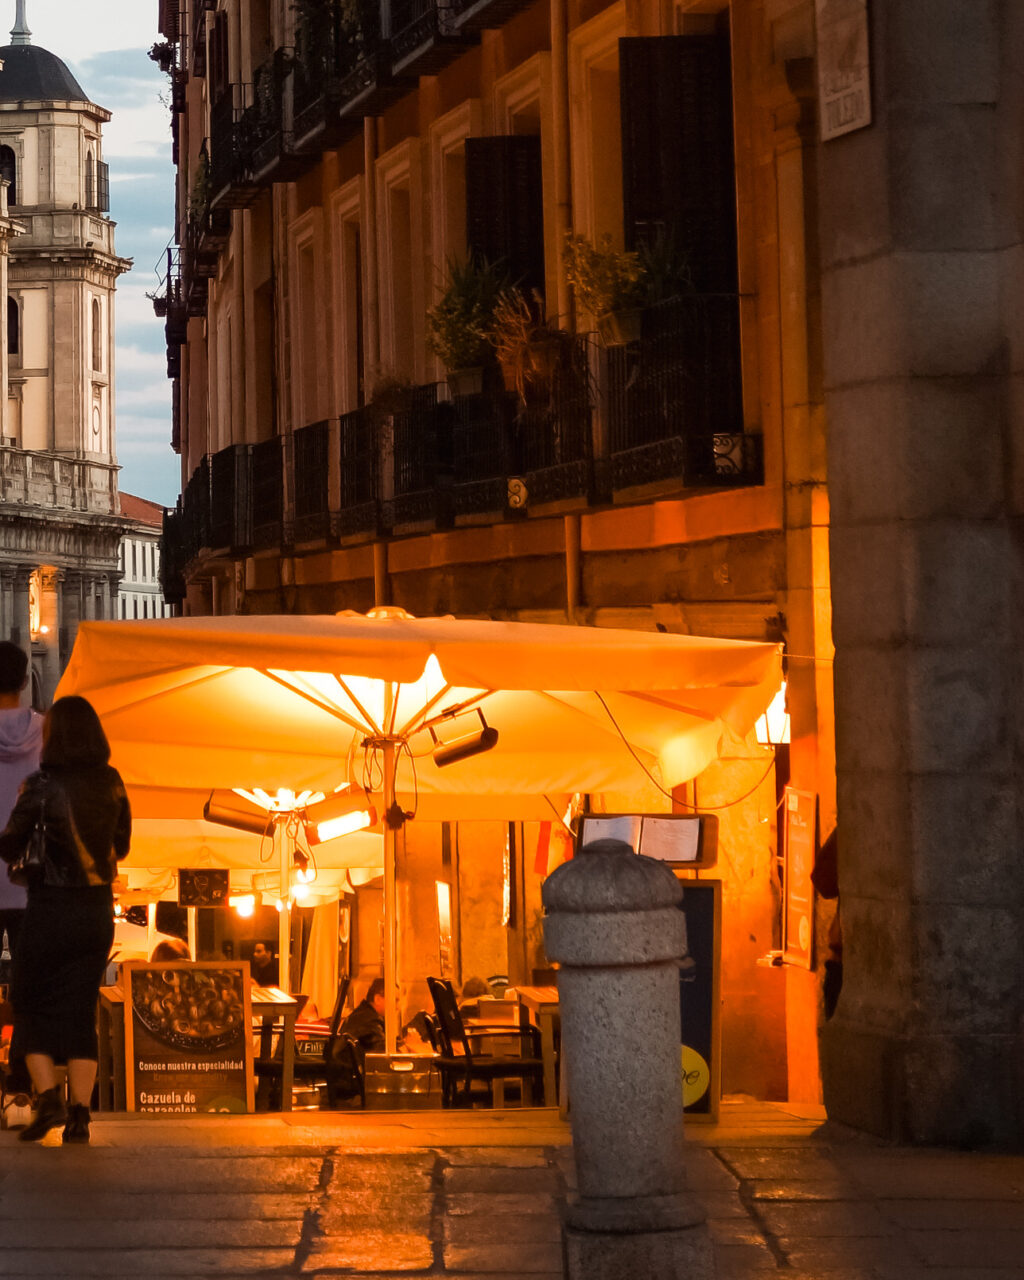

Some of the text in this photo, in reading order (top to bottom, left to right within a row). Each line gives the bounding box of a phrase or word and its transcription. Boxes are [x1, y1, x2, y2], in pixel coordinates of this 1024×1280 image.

[138, 1060, 244, 1072] Conoce nuestra especialidad
[139, 1090, 196, 1104] Cazuela de
